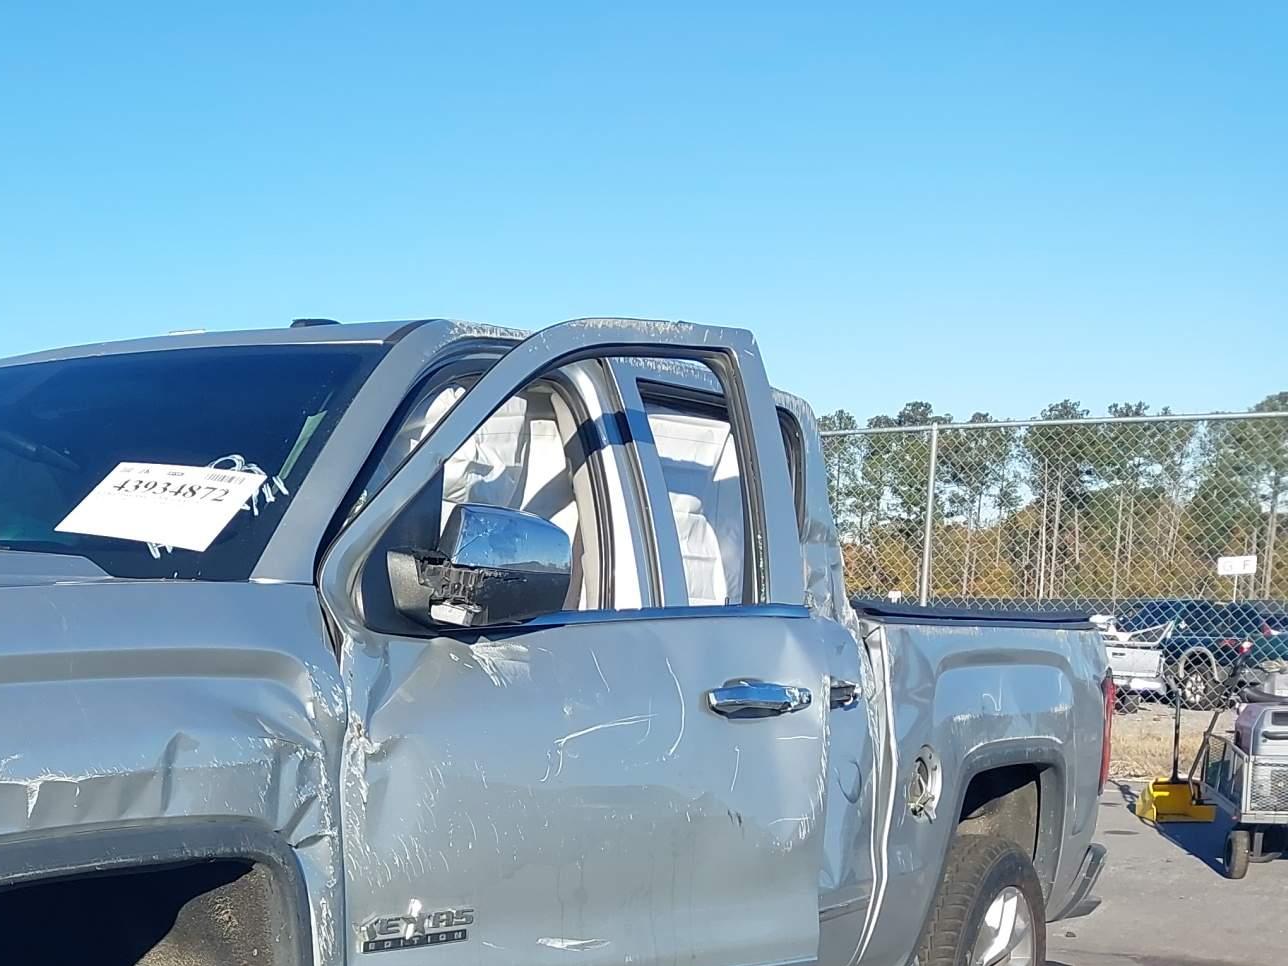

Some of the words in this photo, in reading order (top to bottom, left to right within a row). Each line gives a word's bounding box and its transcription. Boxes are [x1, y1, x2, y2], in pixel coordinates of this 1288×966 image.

[113, 478, 230, 502] 43934872
[353, 907, 475, 941] TEXAS
[368, 931, 463, 950] EDITION
